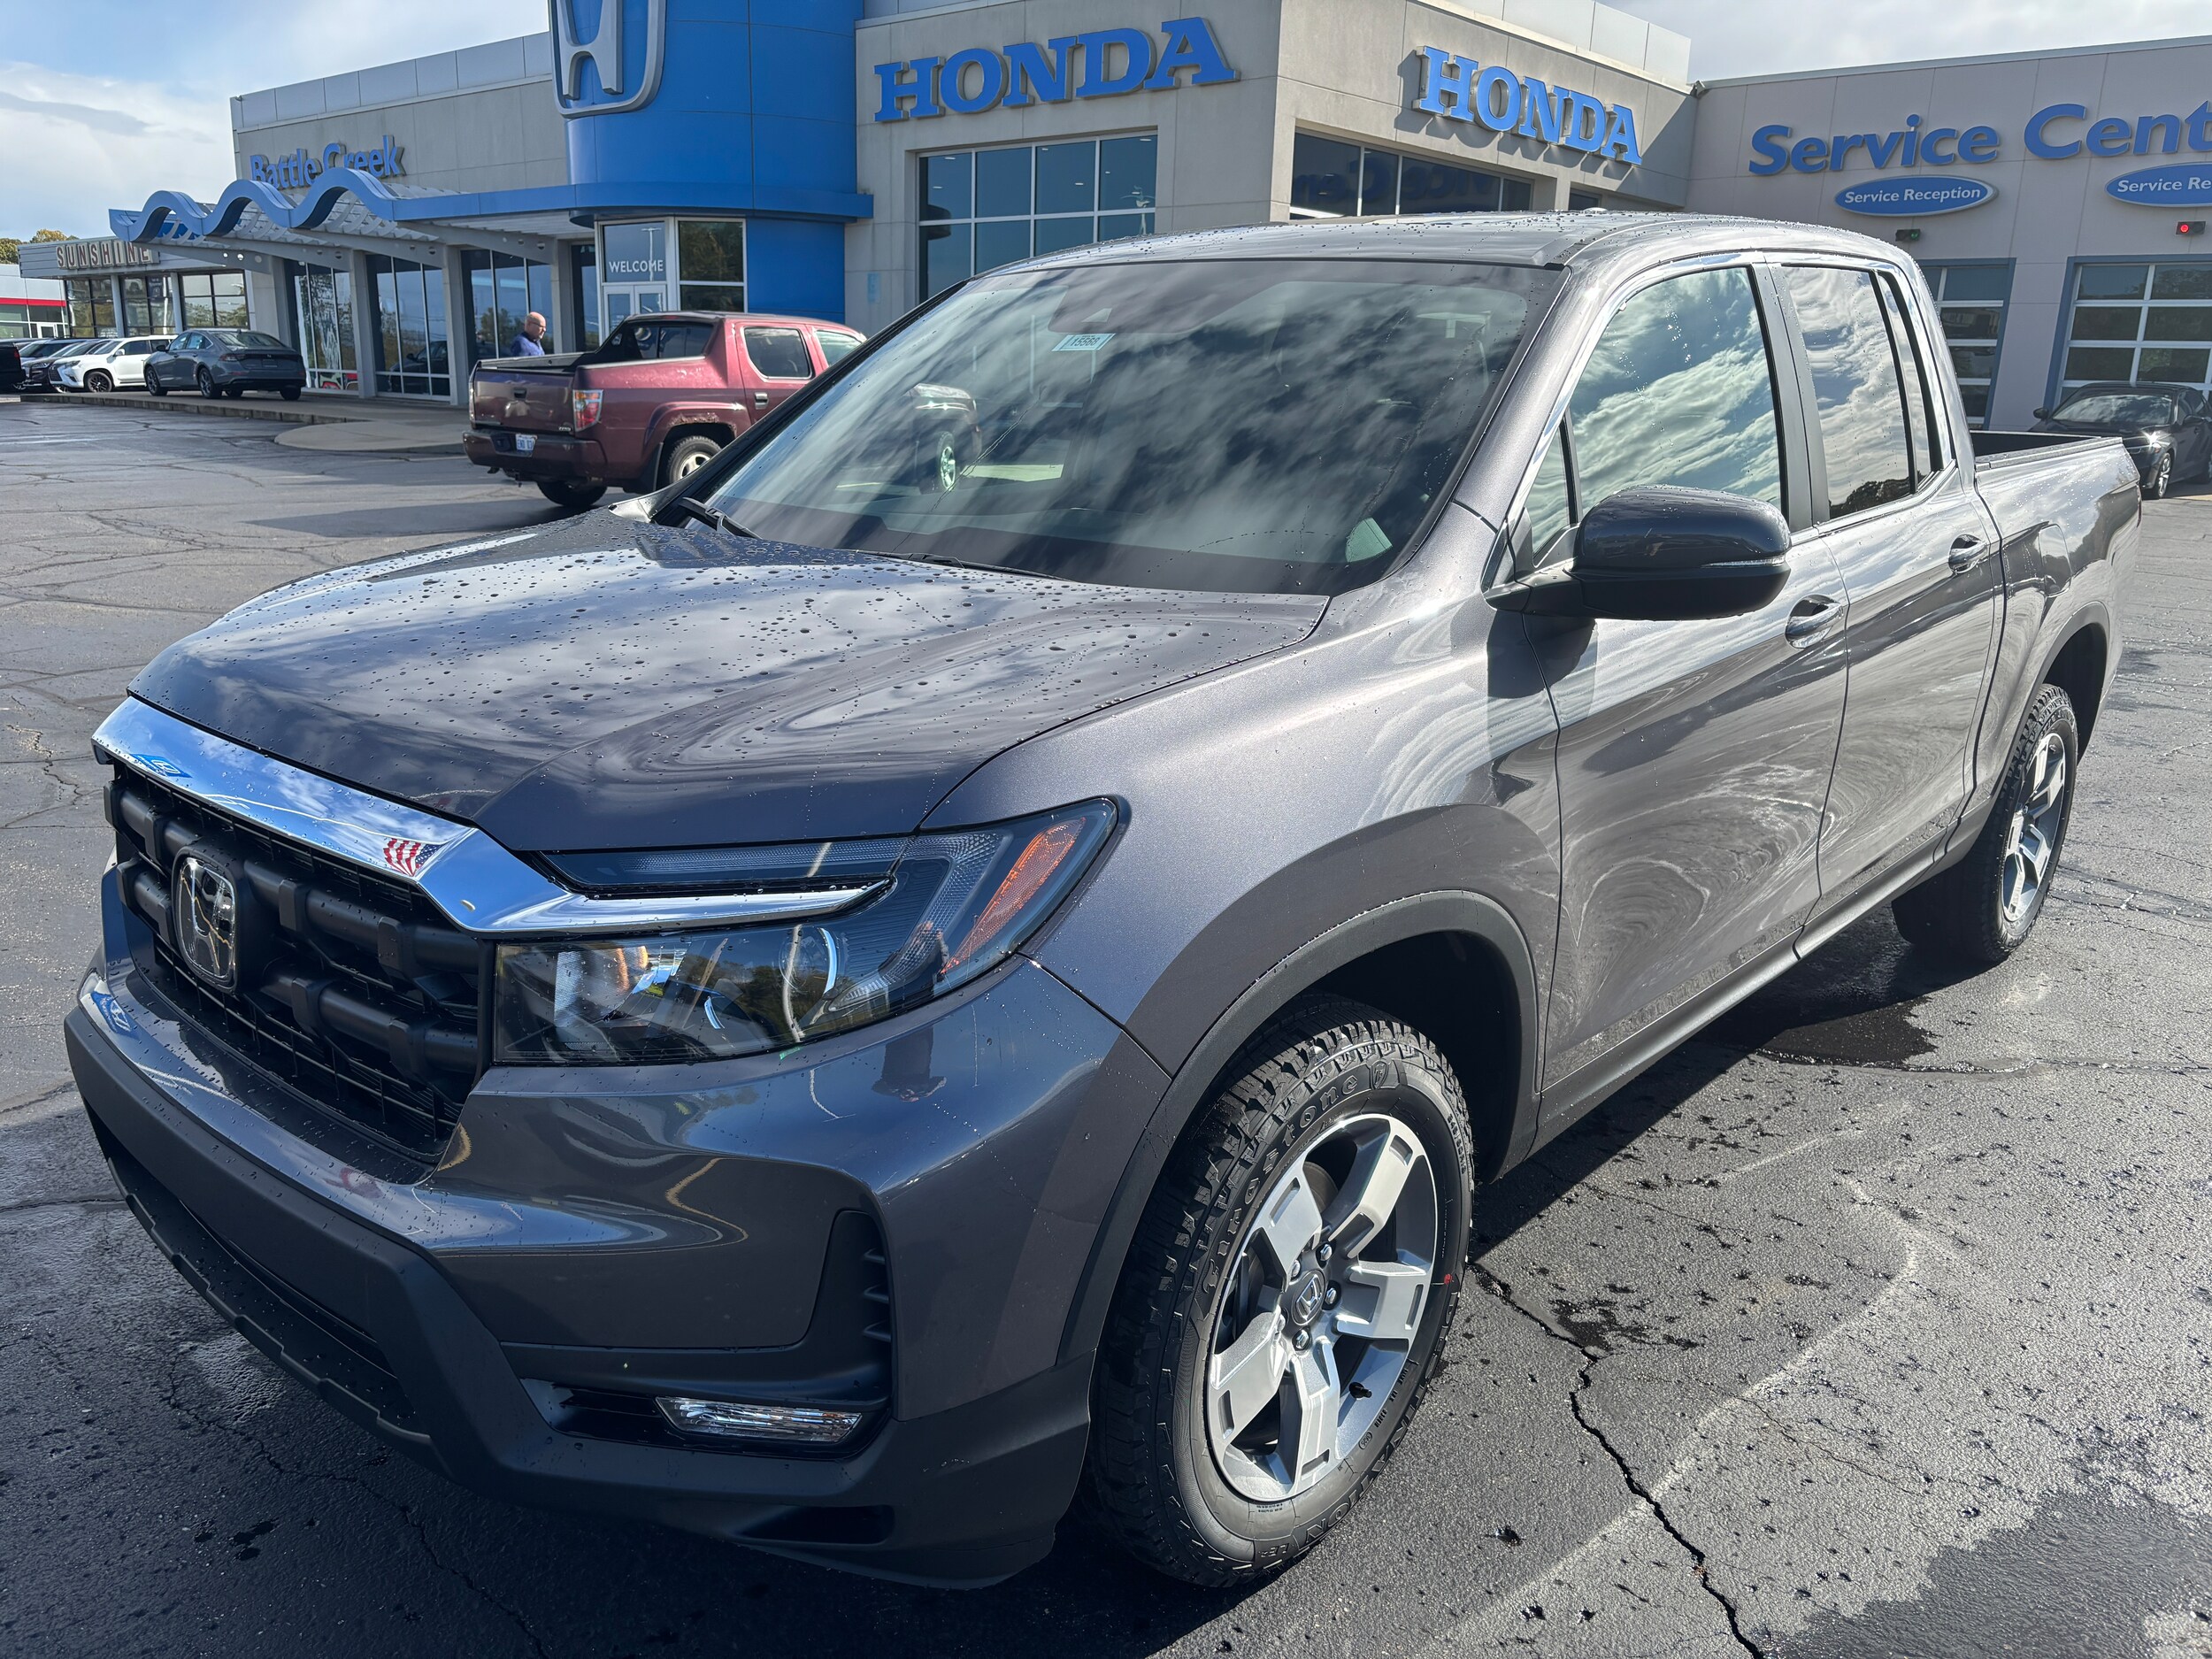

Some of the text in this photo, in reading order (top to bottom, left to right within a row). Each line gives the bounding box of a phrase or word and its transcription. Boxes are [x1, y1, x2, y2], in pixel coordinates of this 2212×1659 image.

[873, 17, 1237, 122] HONDA
[1415, 46, 1643, 165] HONDA
[250, 134, 401, 188] Battle Creek
[1748, 113, 2001, 175] Service
[1844, 187, 1981, 204] Service Reception
[2117, 178, 2183, 193] Service
[57, 241, 150, 268] SUNSHINE
[609, 259, 664, 273] WELCOME
